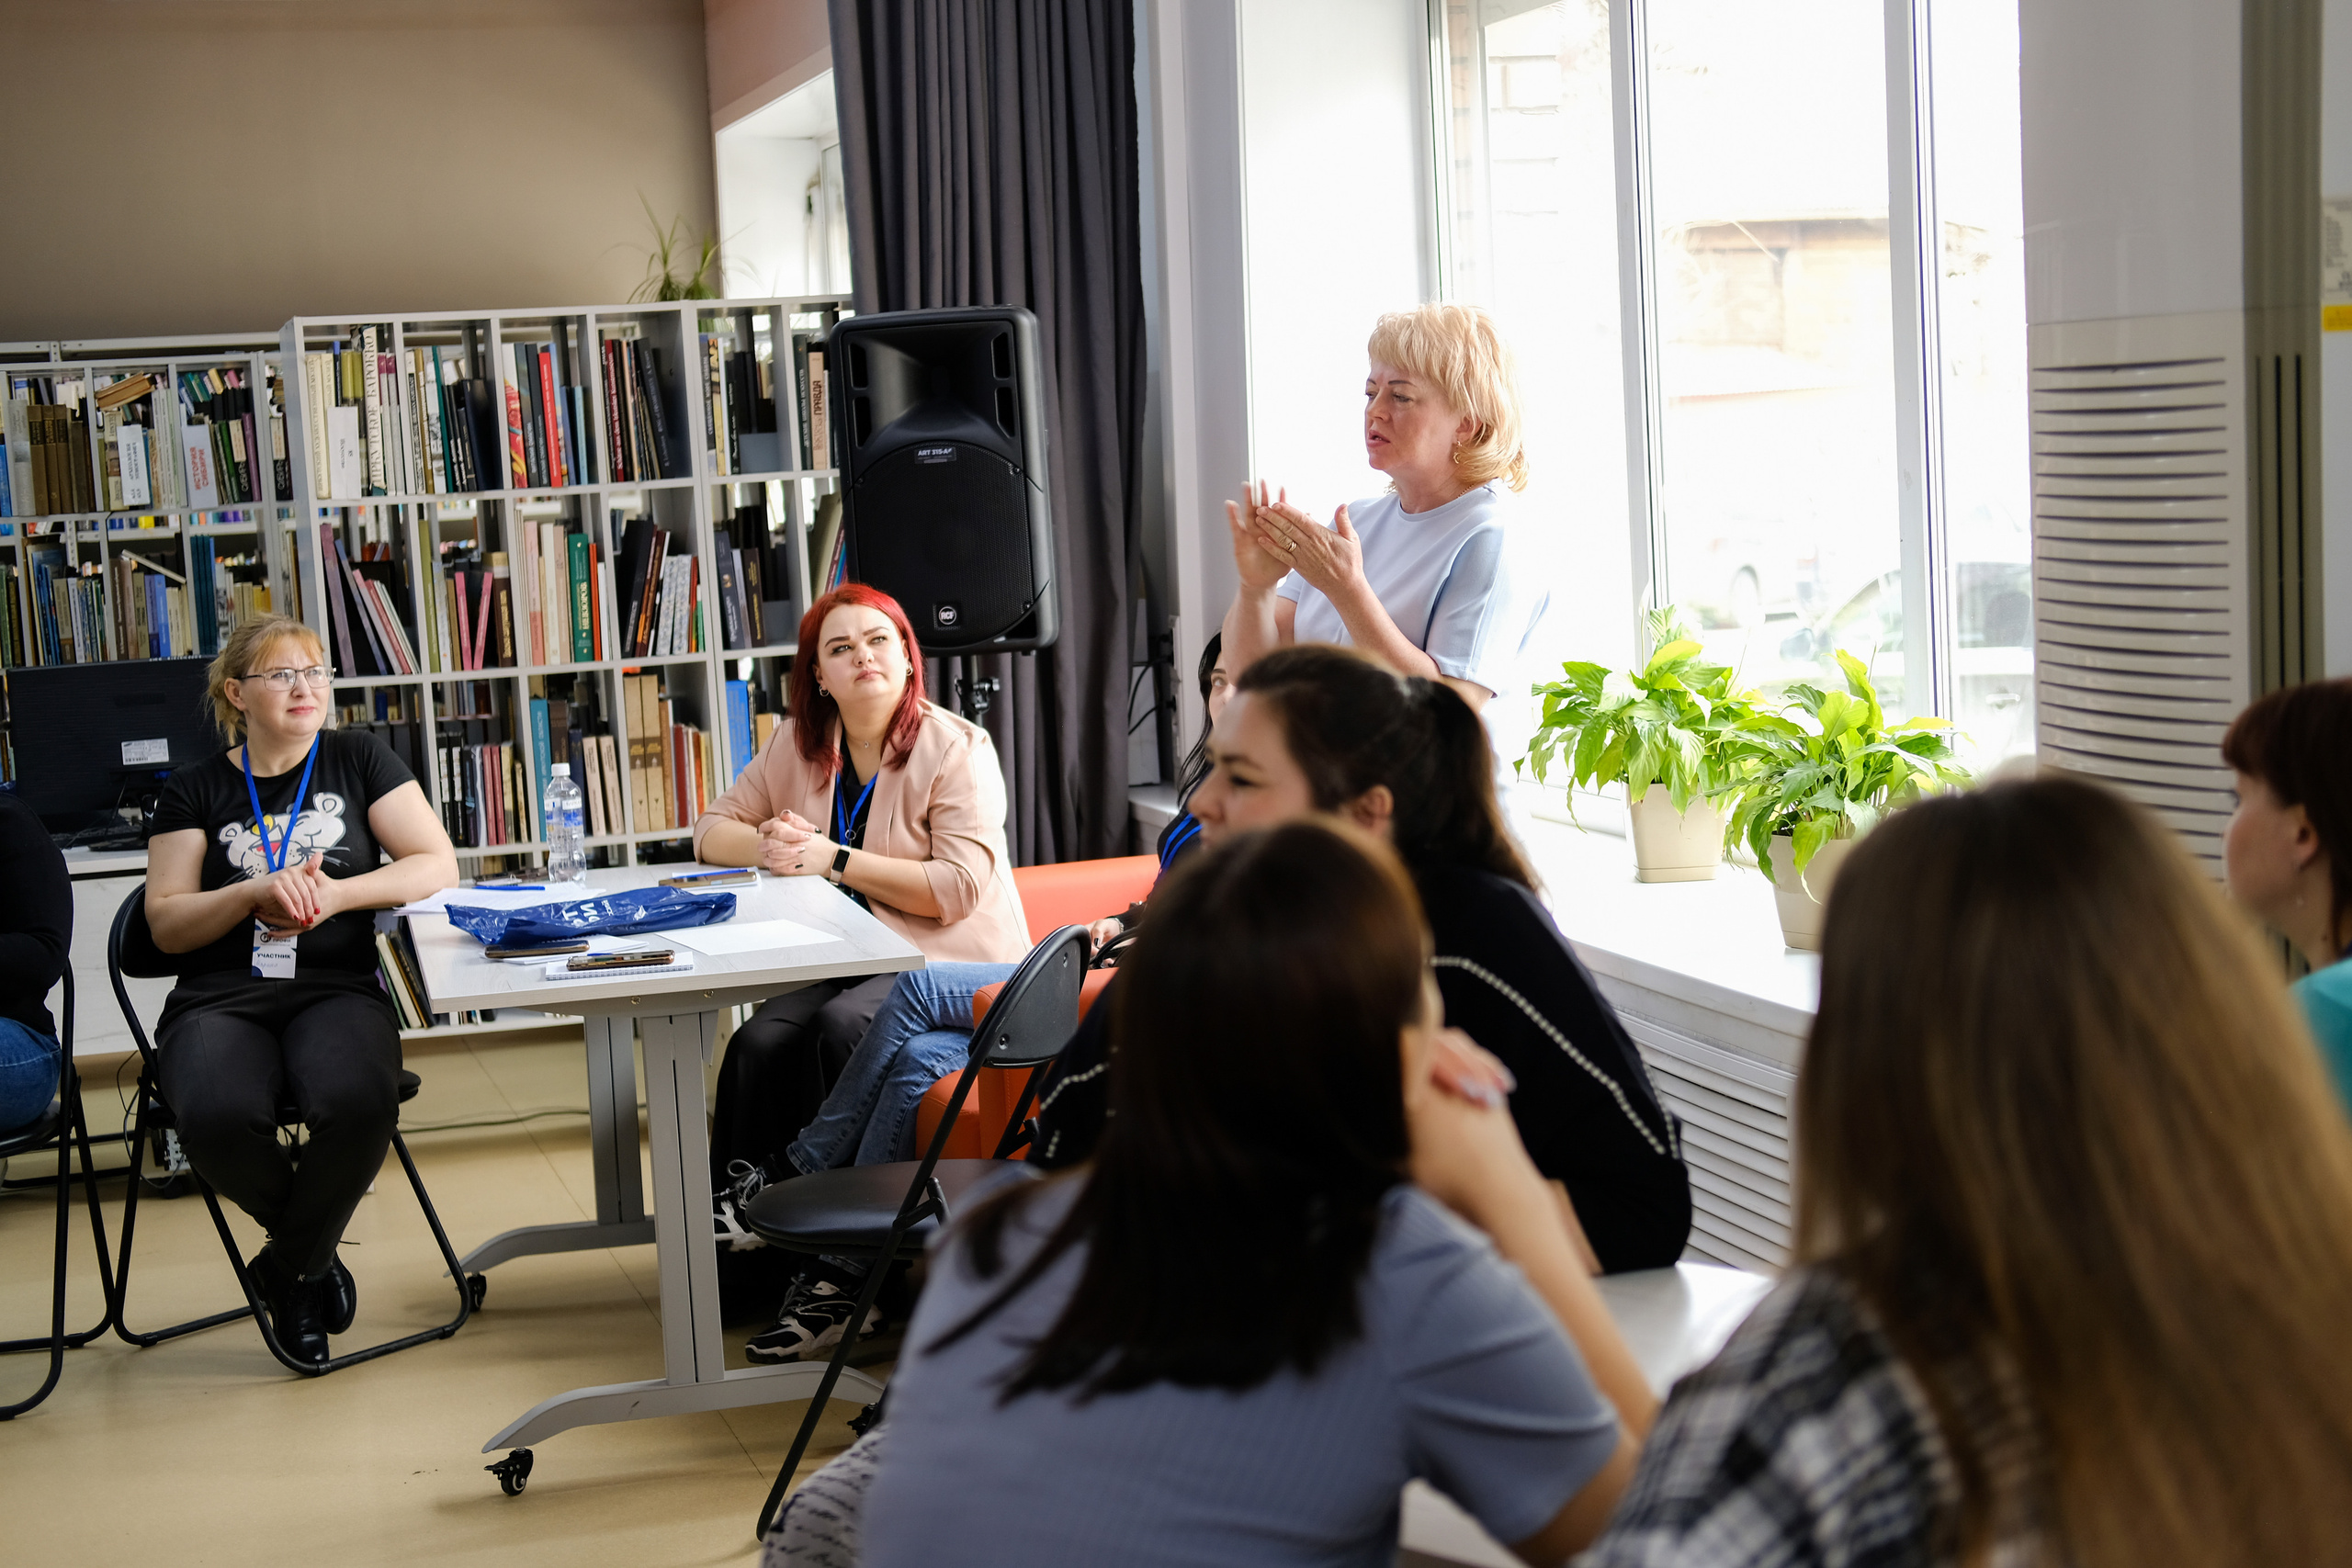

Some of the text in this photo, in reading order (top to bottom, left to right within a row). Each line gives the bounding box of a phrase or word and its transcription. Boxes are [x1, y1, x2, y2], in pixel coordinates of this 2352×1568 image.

[364, 334, 381, 484] ИРКУТСКОЕ БАРОККО
[812, 380, 822, 416] ПРАВДА
[189, 446, 201, 491] ИСТОРИЯ
[198, 448, 209, 487] СИБИРИ
[941, 611, 955, 620] RCF
